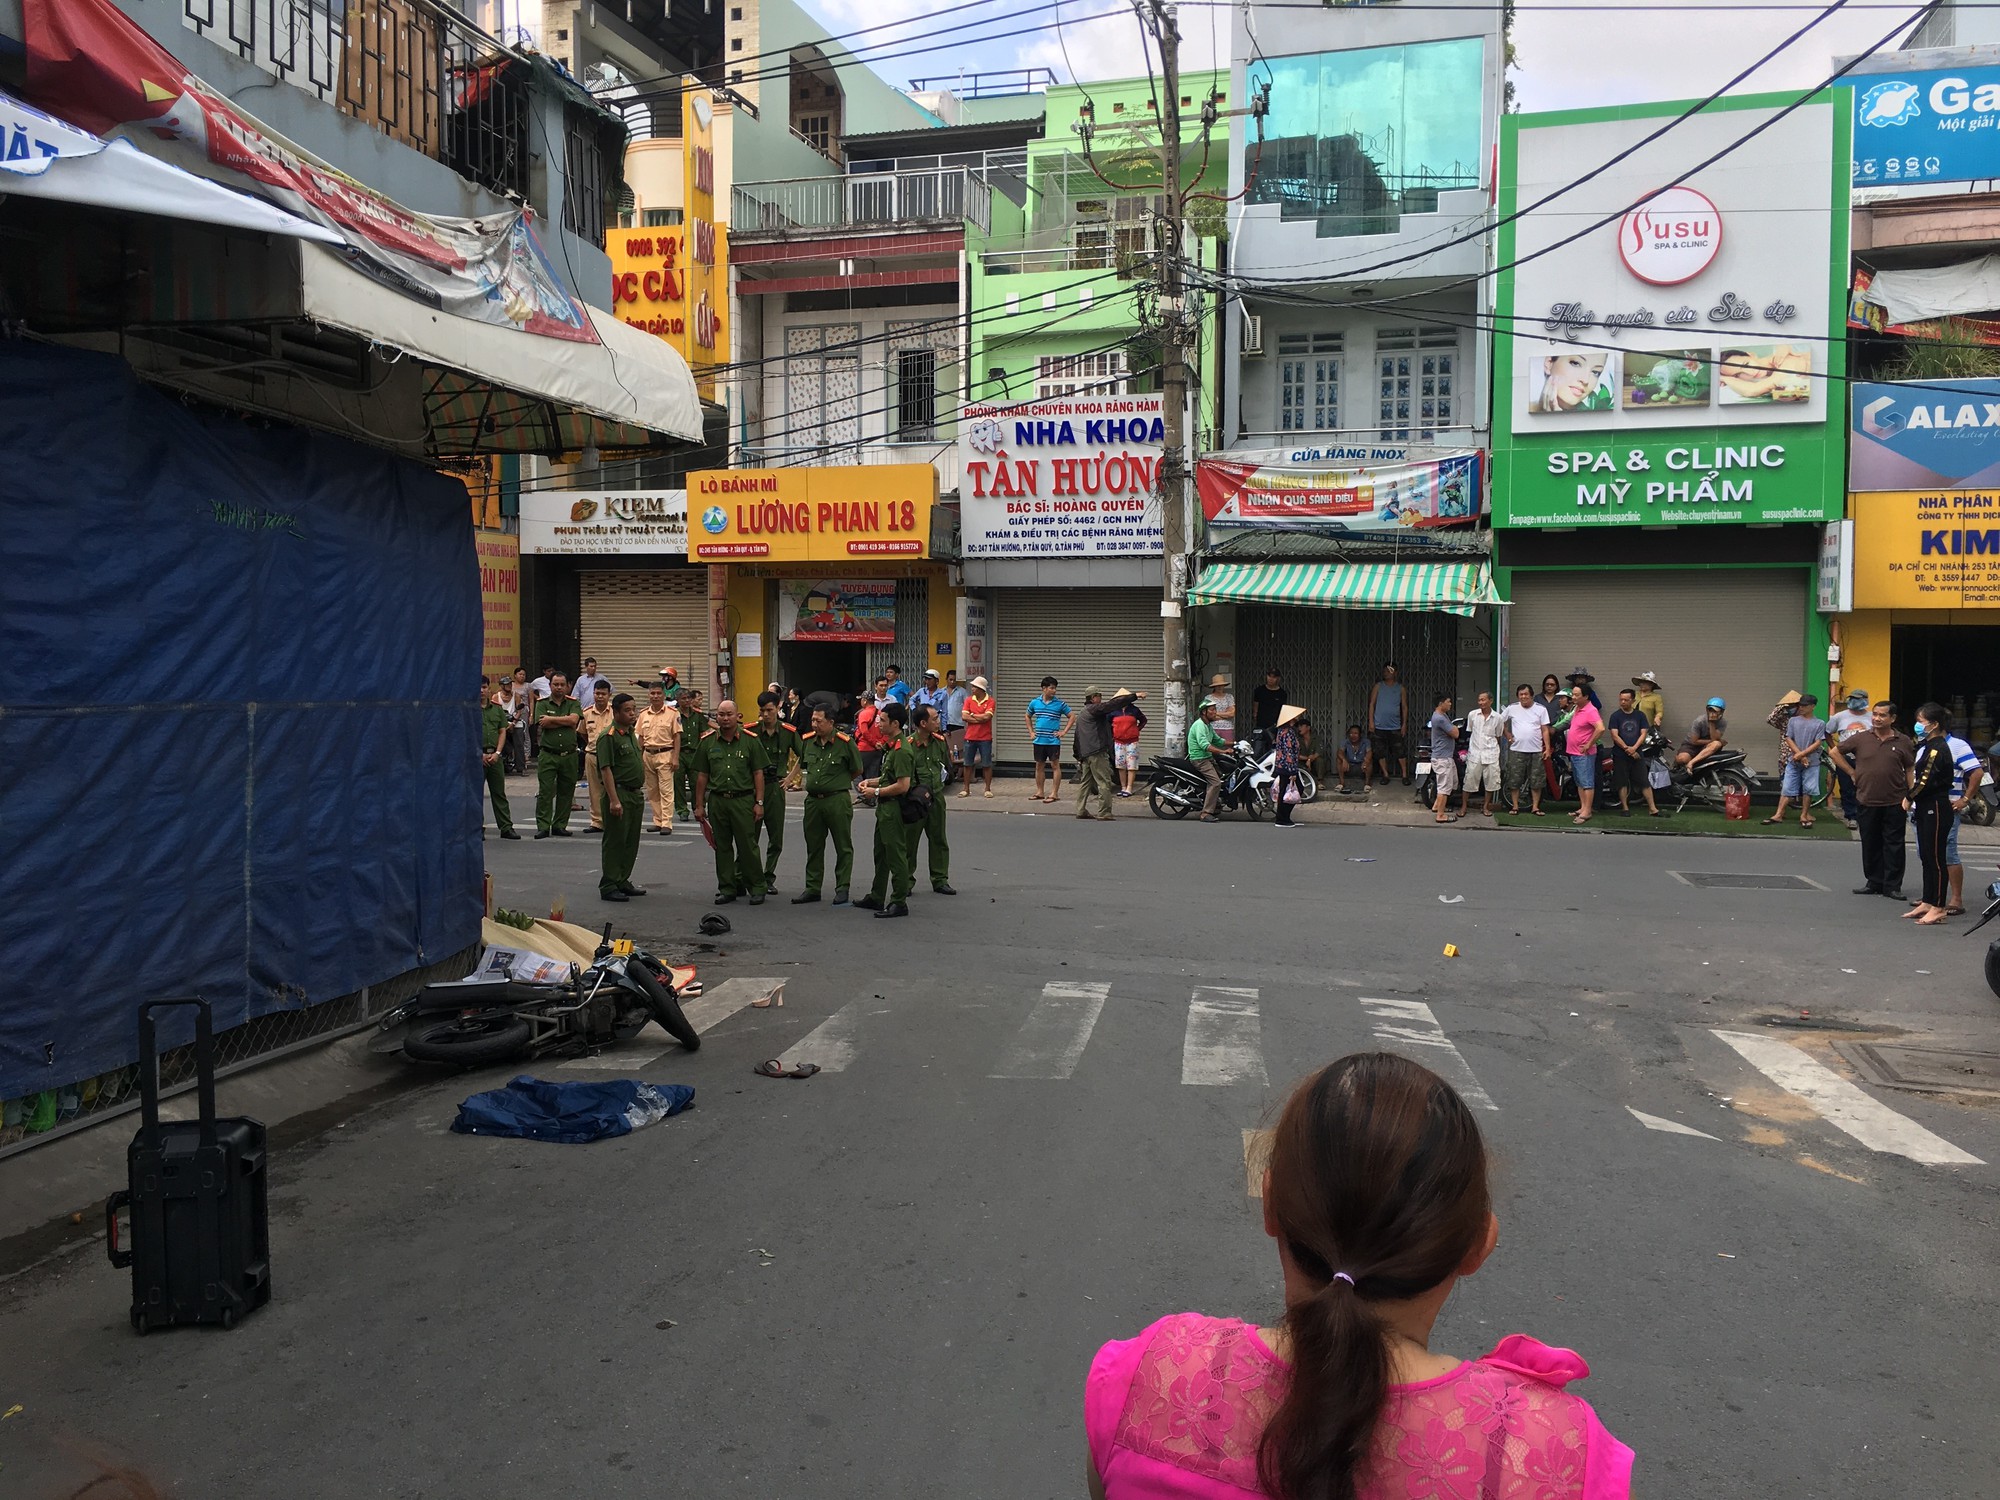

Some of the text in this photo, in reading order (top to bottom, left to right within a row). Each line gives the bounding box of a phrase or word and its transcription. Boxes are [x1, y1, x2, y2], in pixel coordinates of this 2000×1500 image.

[1929, 77, 2000, 115] Ga
[1937, 115, 1994, 132] Một giải
[626, 236, 676, 257] 0908 392
[1654, 240, 1709, 250] SPA & CLINIC
[643, 254, 684, 302] CẨ
[1763, 299, 1796, 324] đẹp
[1031, 401, 1072, 416] CHUYÊN
[1075, 403, 1103, 415] KHOA
[1106, 399, 1133, 413] RĂNG
[1136, 398, 1159, 412] HÀM
[1015, 417, 1164, 446] NHA KHOA
[1291, 447, 1407, 462] CỬA HÀNG INOX
[1548, 445, 1785, 474] SPA & CLINIC
[966, 449, 1039, 497] TÂN
[700, 474, 777, 493] LÒ BÁNH MÌ
[1577, 471, 1753, 505] MỸ PHẨM
[1007, 496, 1144, 513] BÁC SĨ: HOÀNG QUYỀN
[1248, 492, 1354, 508] NHẬN QUÀ SÀNH ĐIỆU
[1918, 493, 1993, 508] NHÀ PHÂN
[736, 498, 915, 534] LƯƠNG PHAN 18
[1008, 515, 1030, 525] GIẤY
[1032, 515, 1056, 525] PHÉP
[1057, 514, 1072, 524] SỐ:
[1074, 516, 1095, 524] 4462
[1103, 515, 1122, 524] GCN
[1124, 515, 1143, 524] HNY
[1917, 511, 1941, 520] CÔNG
[554, 524, 685, 536] PHUN THÊU KỸ THUẬT CHÂU
[985, 529, 1011, 539] KHÁM
[1013, 530, 1020, 538] &
[1045, 529, 1059, 539] TRỊ
[1061, 528, 1080, 537] CÁC
[1082, 527, 1107, 539] BỆNH
[1109, 526, 1134, 537] RĂNG
[968, 544, 977, 552] ĐC:
[978, 544, 988, 552] 247
[989, 542, 1000, 552] TÂN
[1073, 541, 1085, 551] PHÚ
[1096, 542, 1106, 550] ĐT:
[1107, 542, 1117, 550] 028
[1118, 542, 1132, 550] 3847
[1132, 541, 1146, 550] 0097
[1921, 529, 2000, 556] KIM
[1889, 563, 1903, 572] ĐỊA
[1906, 561, 1920, 570] CHỈ
[1940, 561, 1970, 570] NHÁNH:
[499, 565, 517, 594] PHÚ
[1915, 574, 1926, 582] ĐT:
[1942, 574, 1960, 582] 3559
[1964, 594, 1988, 602] Email:
[620, 940, 625, 951] 1
